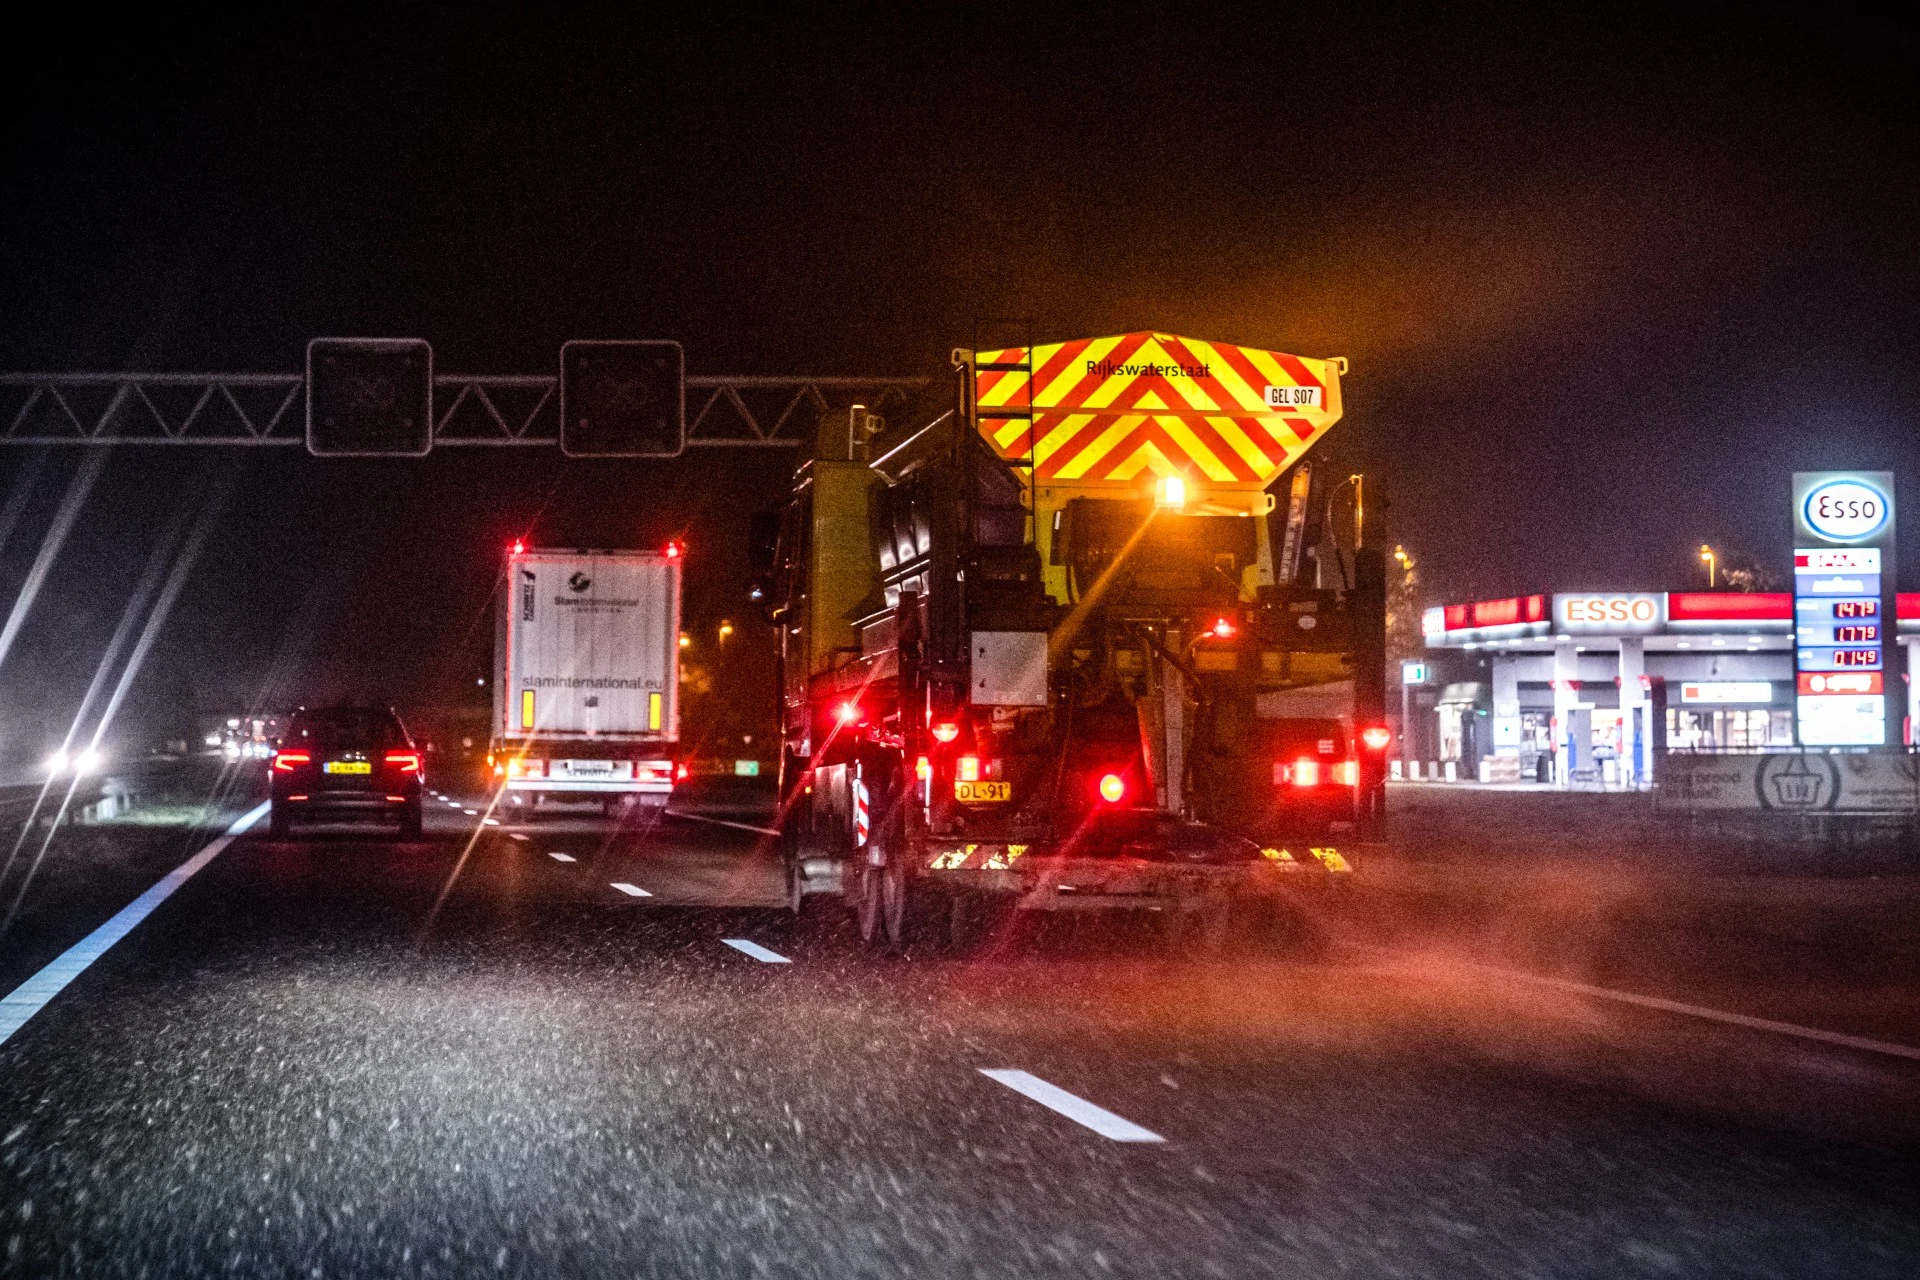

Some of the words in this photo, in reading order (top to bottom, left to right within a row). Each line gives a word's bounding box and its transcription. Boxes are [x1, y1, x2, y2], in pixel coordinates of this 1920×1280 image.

[1086, 360, 1210, 380] Rijkswaterstaat
[1271, 388, 1290, 404] GEL
[1567, 600, 1655, 621] ESSO
